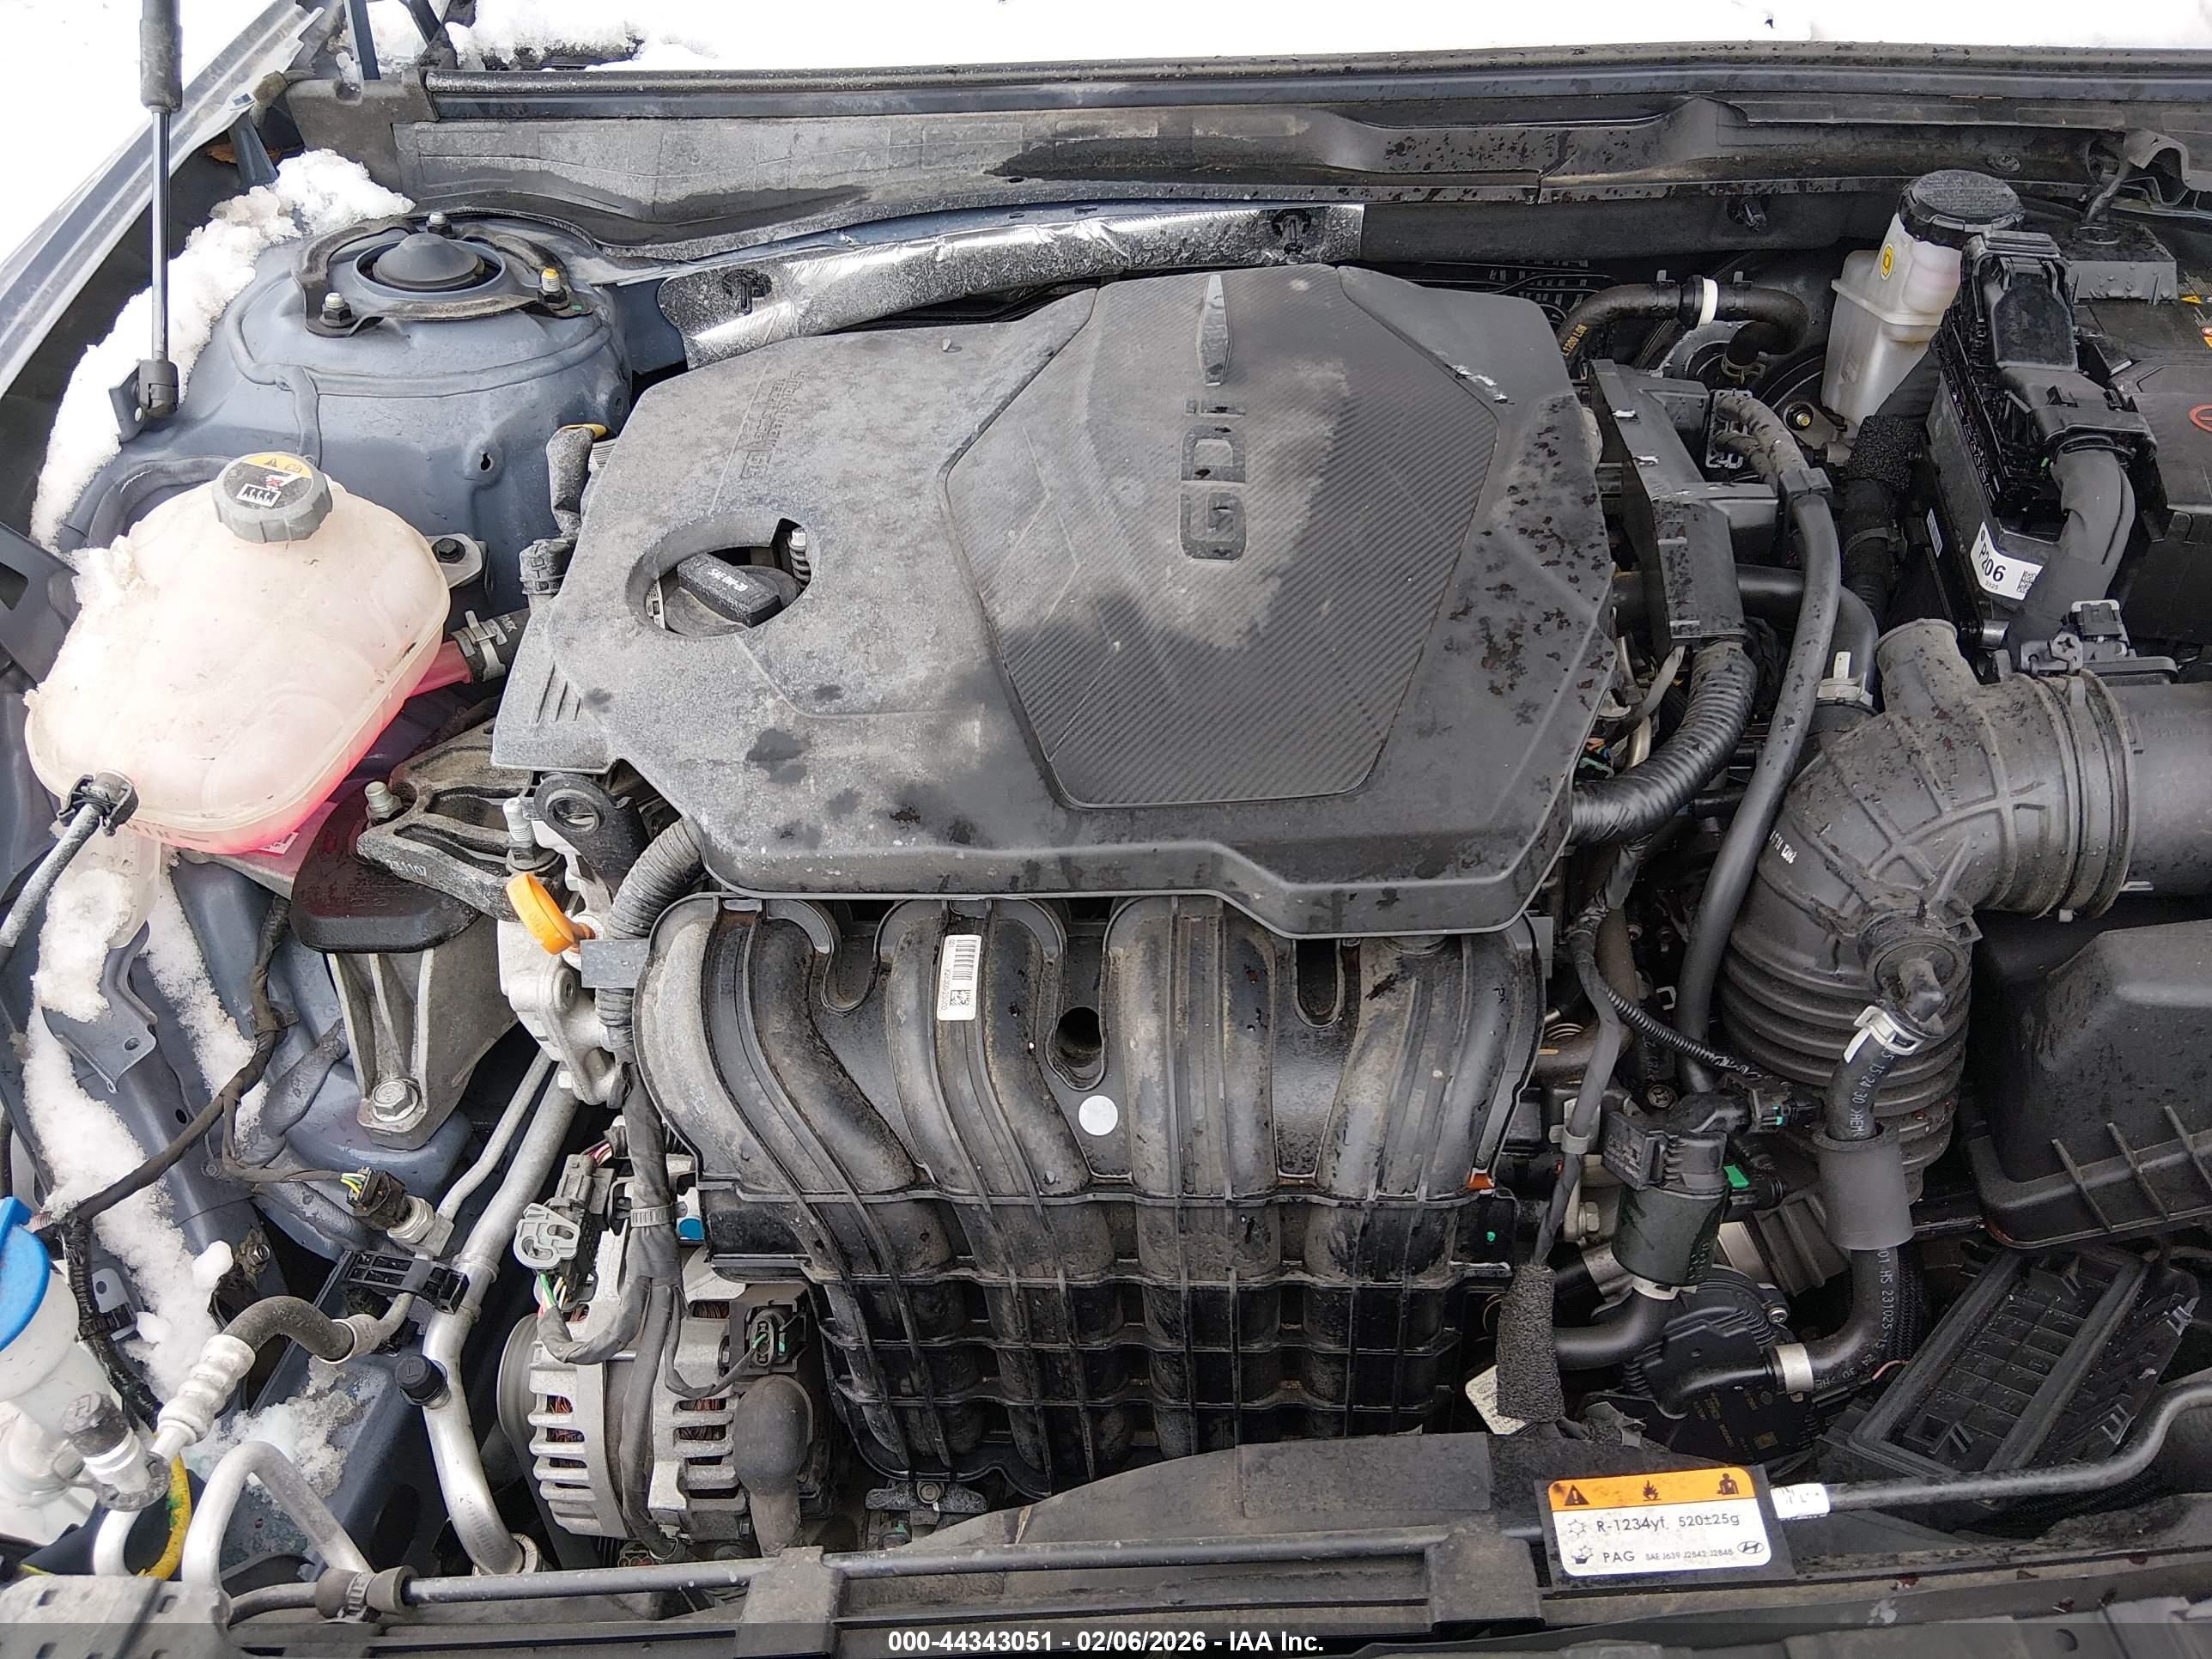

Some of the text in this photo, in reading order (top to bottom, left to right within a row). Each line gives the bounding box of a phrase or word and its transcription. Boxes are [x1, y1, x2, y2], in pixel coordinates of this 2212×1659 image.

[1978, 542, 2007, 582] P206
[1879, 1269, 1893, 1285] HS
[1881, 1290, 1895, 1330] 231025
[1678, 1514, 1740, 1527] 520±25g
[1603, 1551, 1635, 1563] PAG
[1645, 1553, 1660, 1561] SAE
[1662, 1551, 1680, 1560] J639
